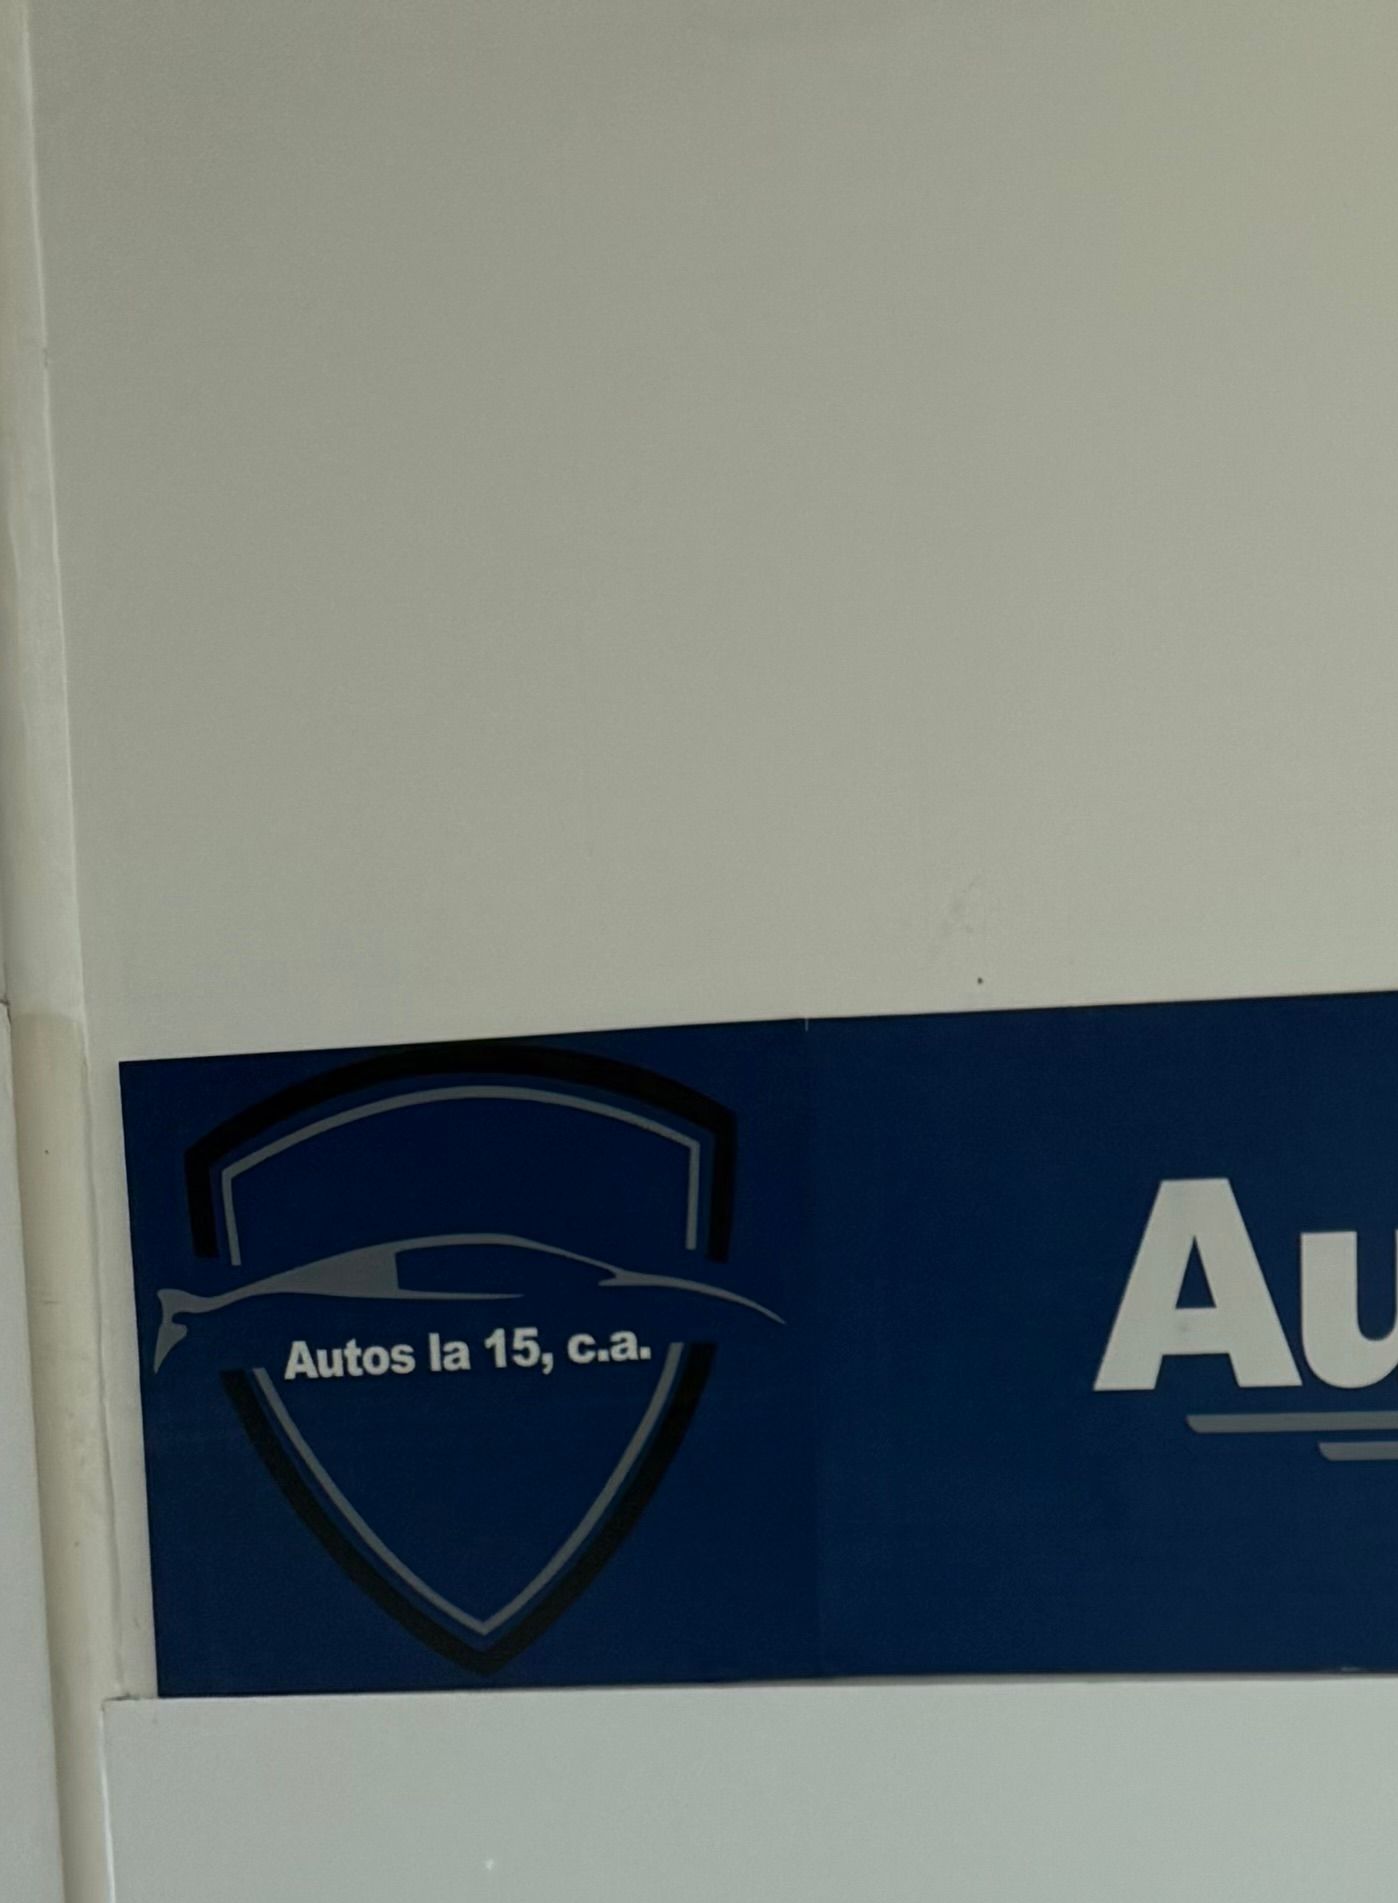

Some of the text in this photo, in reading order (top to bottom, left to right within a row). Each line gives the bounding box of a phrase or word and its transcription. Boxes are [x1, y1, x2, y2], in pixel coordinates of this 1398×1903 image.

[283, 1327, 652, 1380] Autos la 15, c.a.
